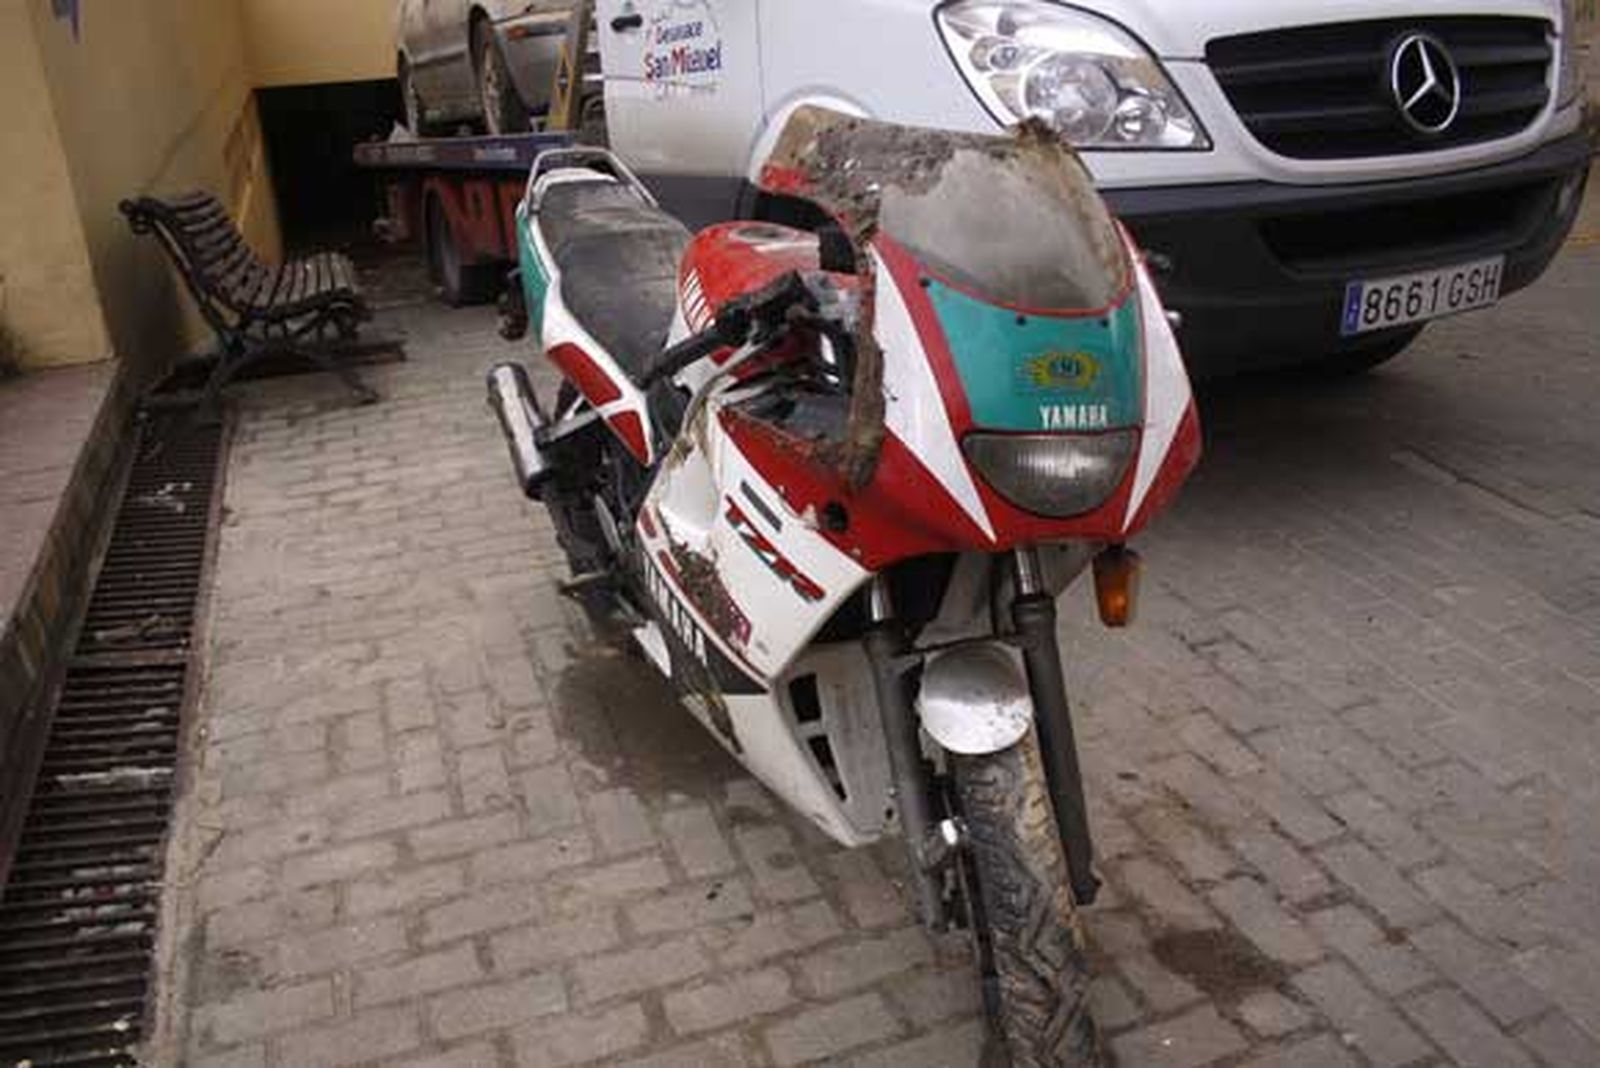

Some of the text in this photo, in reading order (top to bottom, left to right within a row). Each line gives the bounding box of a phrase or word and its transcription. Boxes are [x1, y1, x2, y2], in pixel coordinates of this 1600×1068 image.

[644, 53, 670, 80] San
[1363, 276, 1441, 324] 8661
[1448, 263, 1499, 308] GSH
[1039, 404, 1107, 430] YAMAHA
